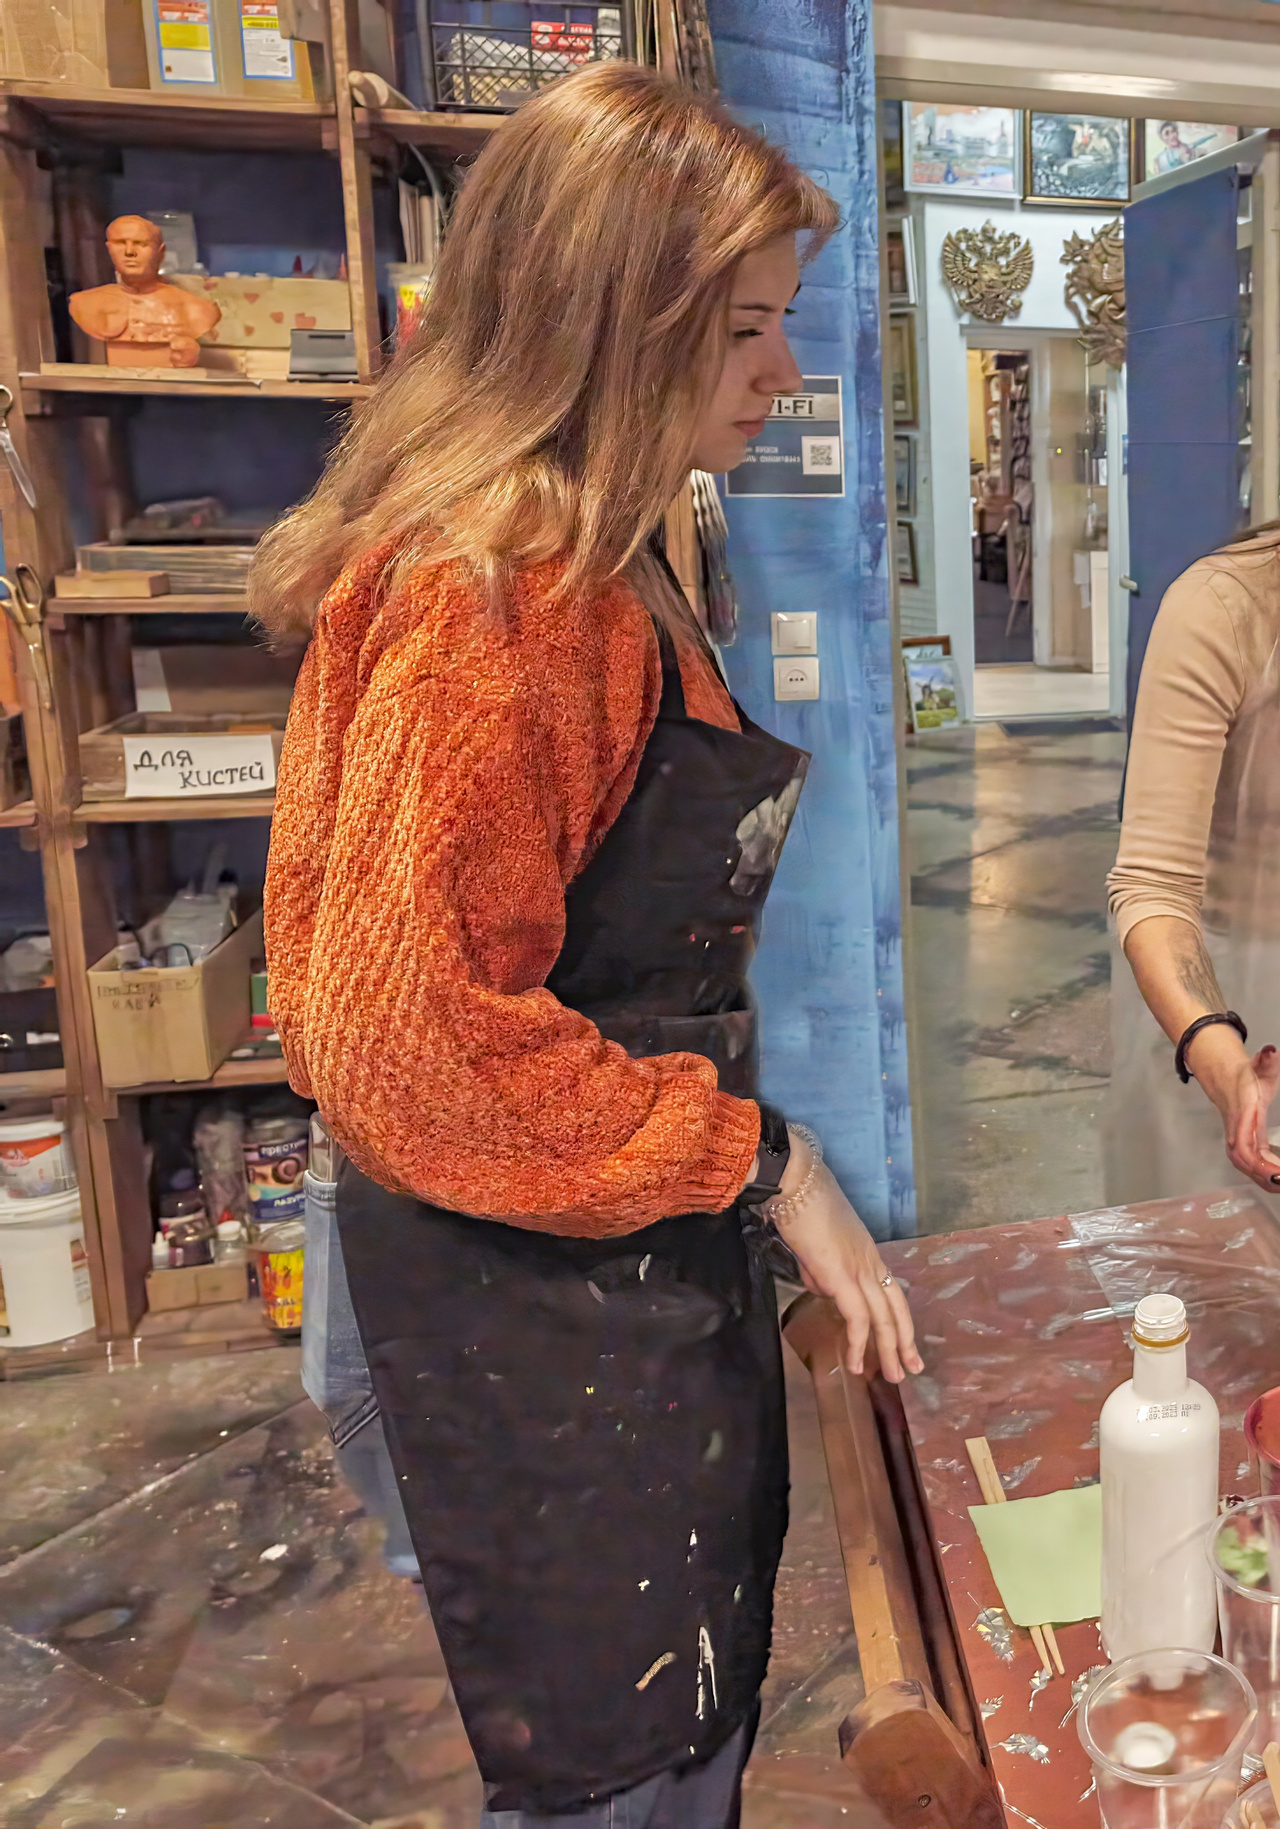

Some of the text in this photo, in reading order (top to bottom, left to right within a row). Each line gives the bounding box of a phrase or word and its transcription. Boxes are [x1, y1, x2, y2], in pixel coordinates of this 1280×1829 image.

[771, 399, 813, 414] I-FI
[133, 750, 193, 771] ДЛЯ
[179, 762, 264, 789] КИСТЕЙ
